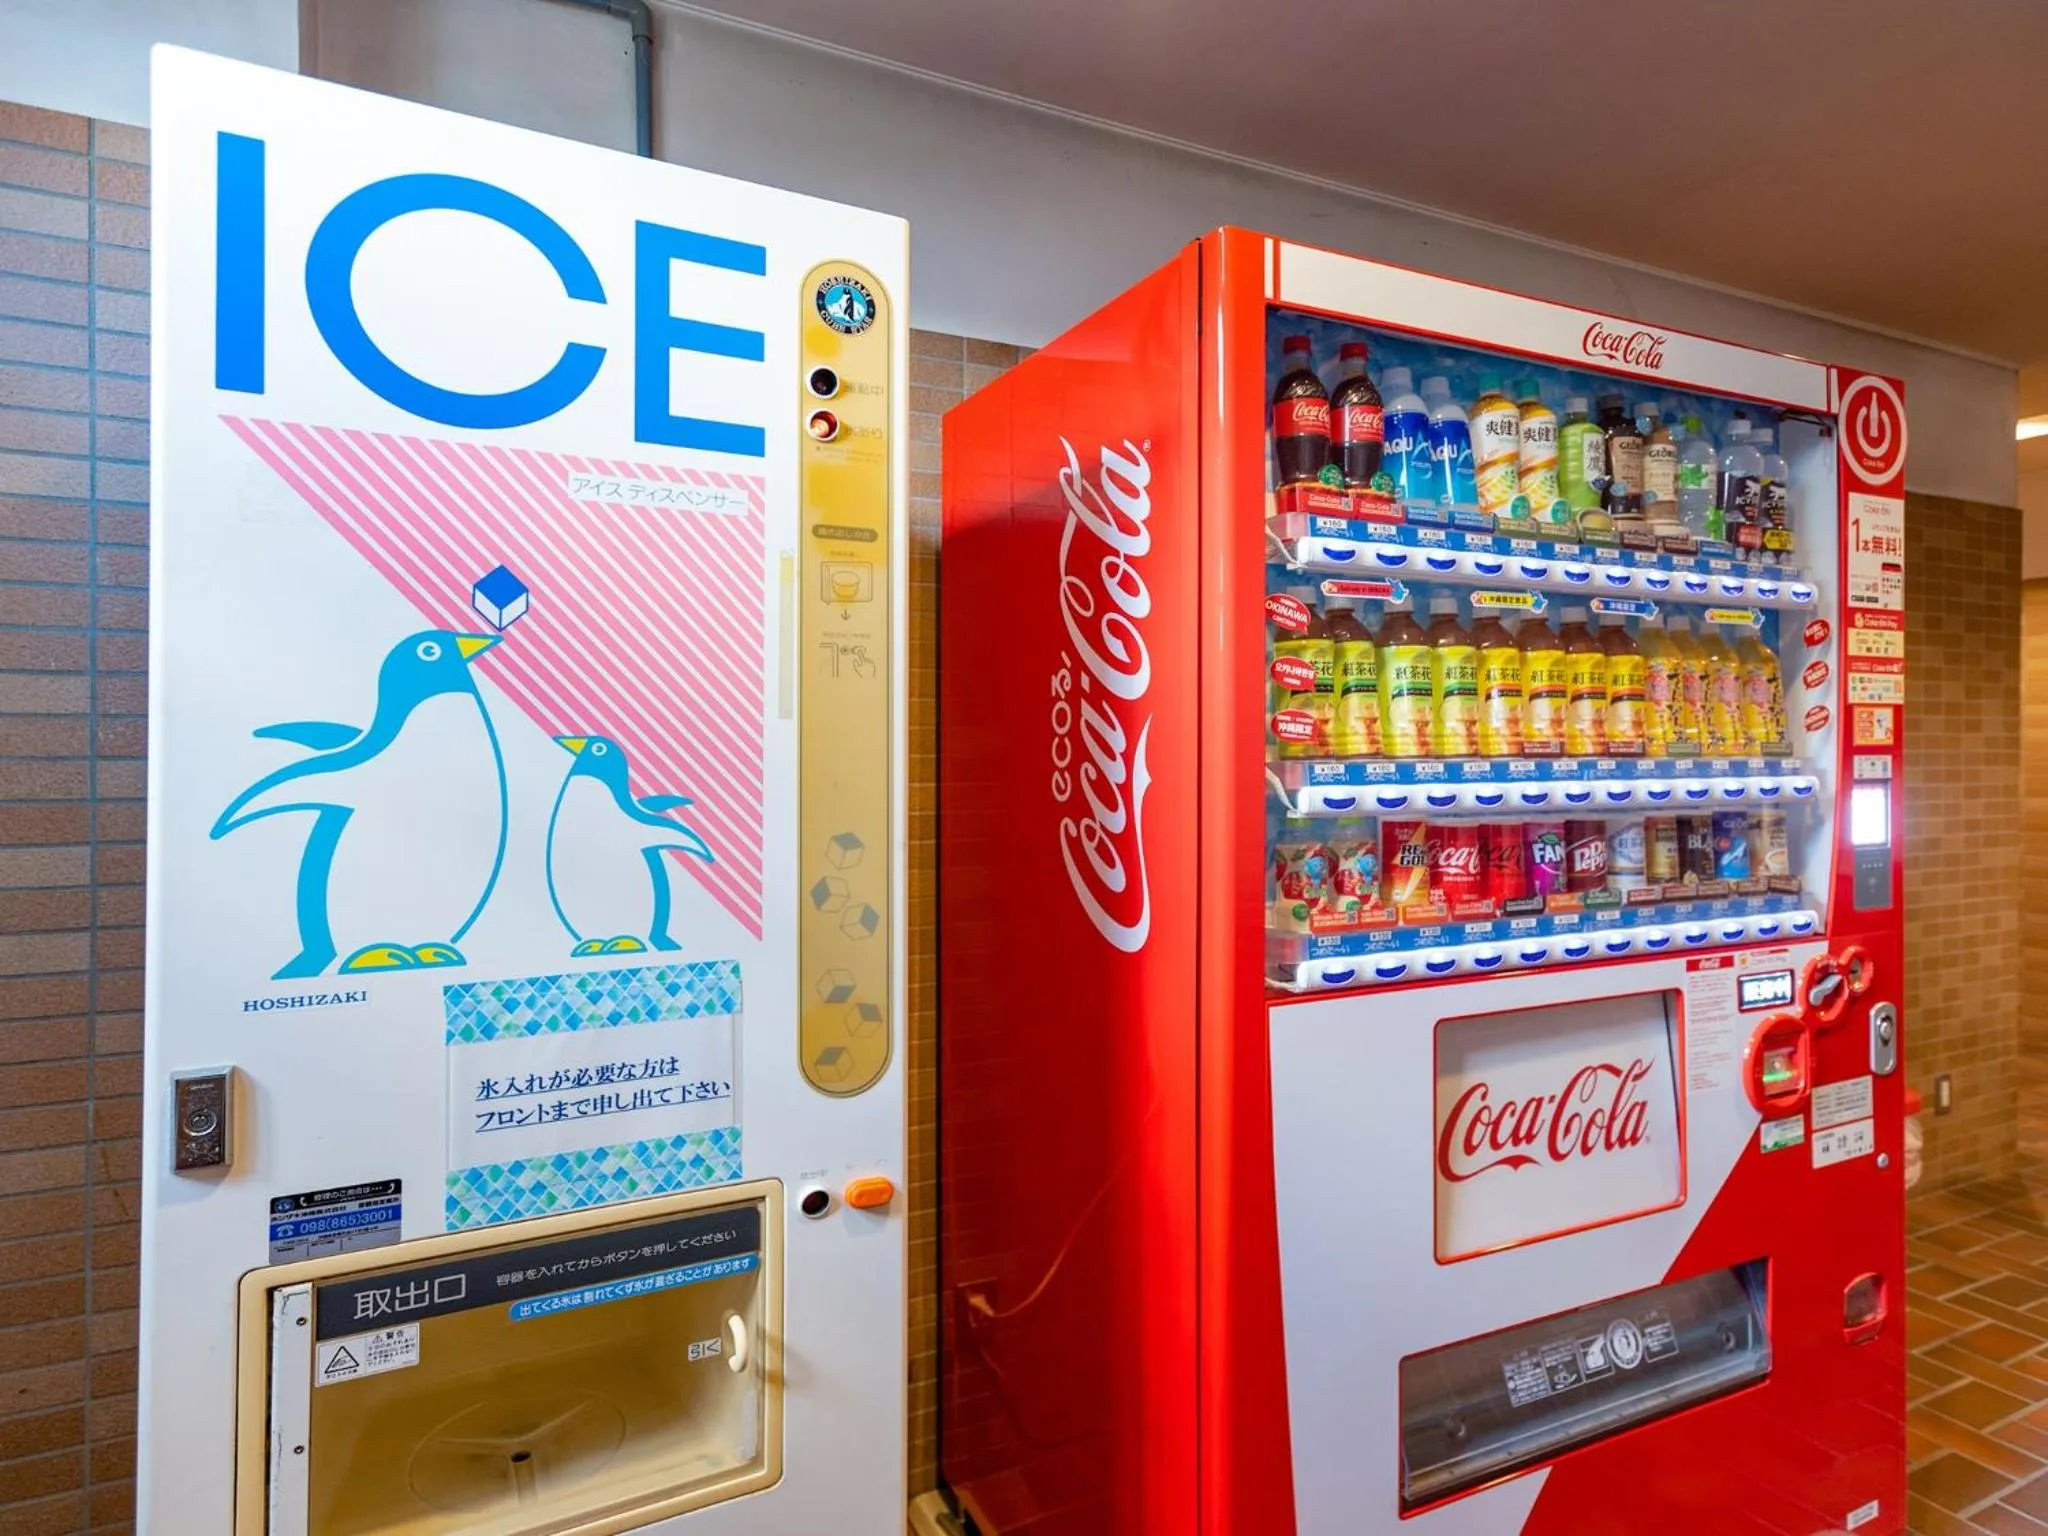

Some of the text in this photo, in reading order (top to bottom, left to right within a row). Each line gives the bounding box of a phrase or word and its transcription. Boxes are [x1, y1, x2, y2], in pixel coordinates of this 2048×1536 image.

[215, 130, 765, 457] ICE
[1583, 322, 1669, 369] Coca-Cola
[574, 478, 744, 509] アイス ディスペンサー
[1265, 600, 1308, 622] OKINAWA
[1060, 436, 1152, 953] Coca-Cola
[243, 991, 368, 1012] HOSHIZAKI
[477, 1056, 680, 1099] 氷入れが必要な方は
[476, 1081, 731, 1131] フロントまで申し出て下さい
[1438, 1058, 1655, 1182] Coca-Cola
[496, 1229, 737, 1287] 容器を入れてからボタンを押してください
[354, 1274, 466, 1320] 取出口
[690, 1339, 720, 1361] 引く
